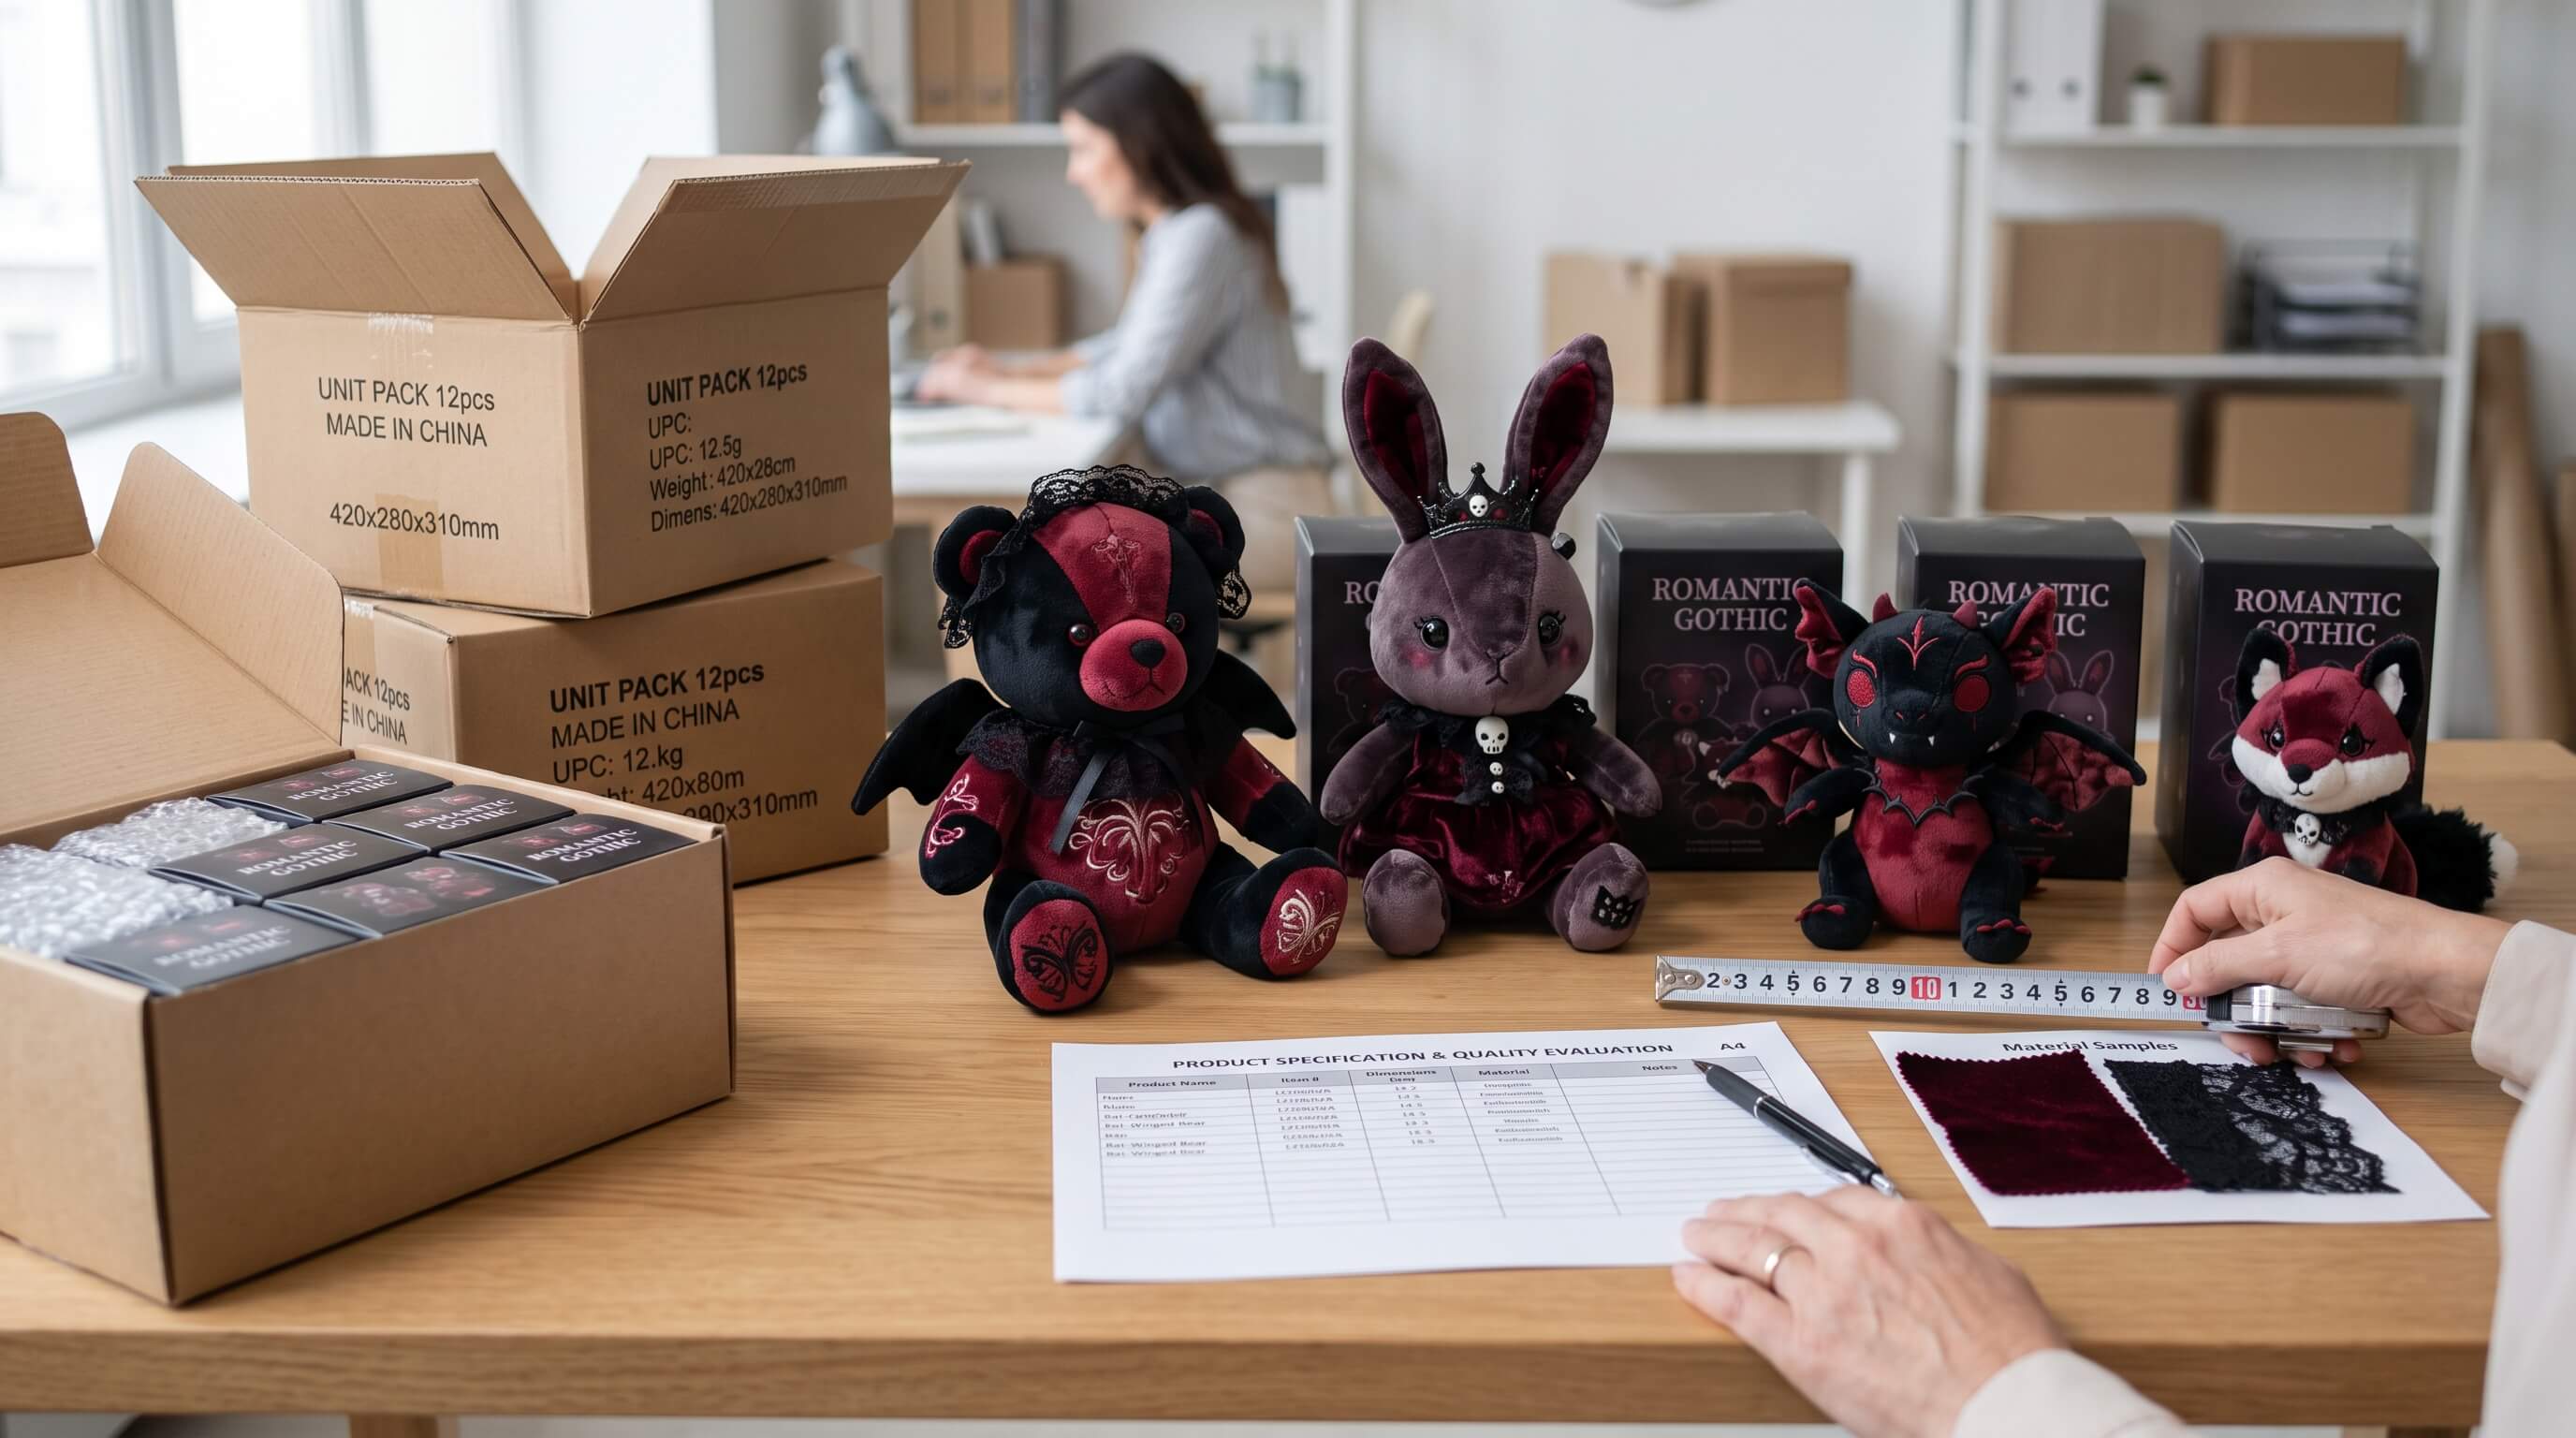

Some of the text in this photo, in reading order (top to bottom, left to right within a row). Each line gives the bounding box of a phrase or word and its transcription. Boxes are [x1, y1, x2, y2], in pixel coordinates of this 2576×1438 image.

[318, 376, 495, 415] UNIT PACK 12pcs
[648, 363, 808, 406] UNIT PACK 12pcs
[327, 412, 488, 448] MADE IN CHINA
[648, 411, 692, 439] UPC:
[650, 434, 742, 471] UPC: 12.5g
[717, 456, 796, 488] 420x28cm
[329, 502, 500, 540] 420x280x310mm
[651, 475, 848, 533] Dimens: 420x280x310mm
[1947, 580, 2110, 608] ROMATIC
[2233, 588, 2402, 617] ROMANTIC
[1674, 607, 1788, 631] GOTHIC
[344, 666, 372, 697] ACK
[374, 677, 411, 712] 12pcs
[549, 664, 765, 713] UNIT PACK 12pcs
[351, 702, 364, 728] IN
[367, 709, 408, 746] CHINA
[551, 698, 740, 749] MADE IN CHINA
[553, 744, 683, 785] UPC: 12.kg
[642, 770, 745, 803] 420x80m
[1706, 972, 1720, 989] 2
[1734, 973, 1748, 990] 3
[1759, 974, 1775, 990] 4
[1787, 975, 1800, 991] 5
[1813, 976, 1827, 992] 6
[1839, 976, 1852, 993] 7
[1866, 977, 1880, 994] 8
[1892, 978, 1906, 995] 9
[1915, 978, 1938, 998] 10
[1948, 981, 1957, 998] 1
[1973, 982, 1987, 999] 2
[2000, 983, 2014, 1000] 3
[2027, 984, 2042, 1001] 4
[2055, 986, 2068, 1002] 5
[2081, 986, 2095, 1003] 6
[2108, 987, 2122, 1004] 7
[2135, 988, 2150, 1005] 8
[2162, 989, 2177, 1006] 9
[1173, 1044, 1674, 1069] PRODUCT SPECIFICATION & QUALITY EVALUATION
[1720, 1042, 1748, 1050] A4
[2002, 1041, 2178, 1052] Material Samples
[1642, 1064, 1678, 1072] Notes
